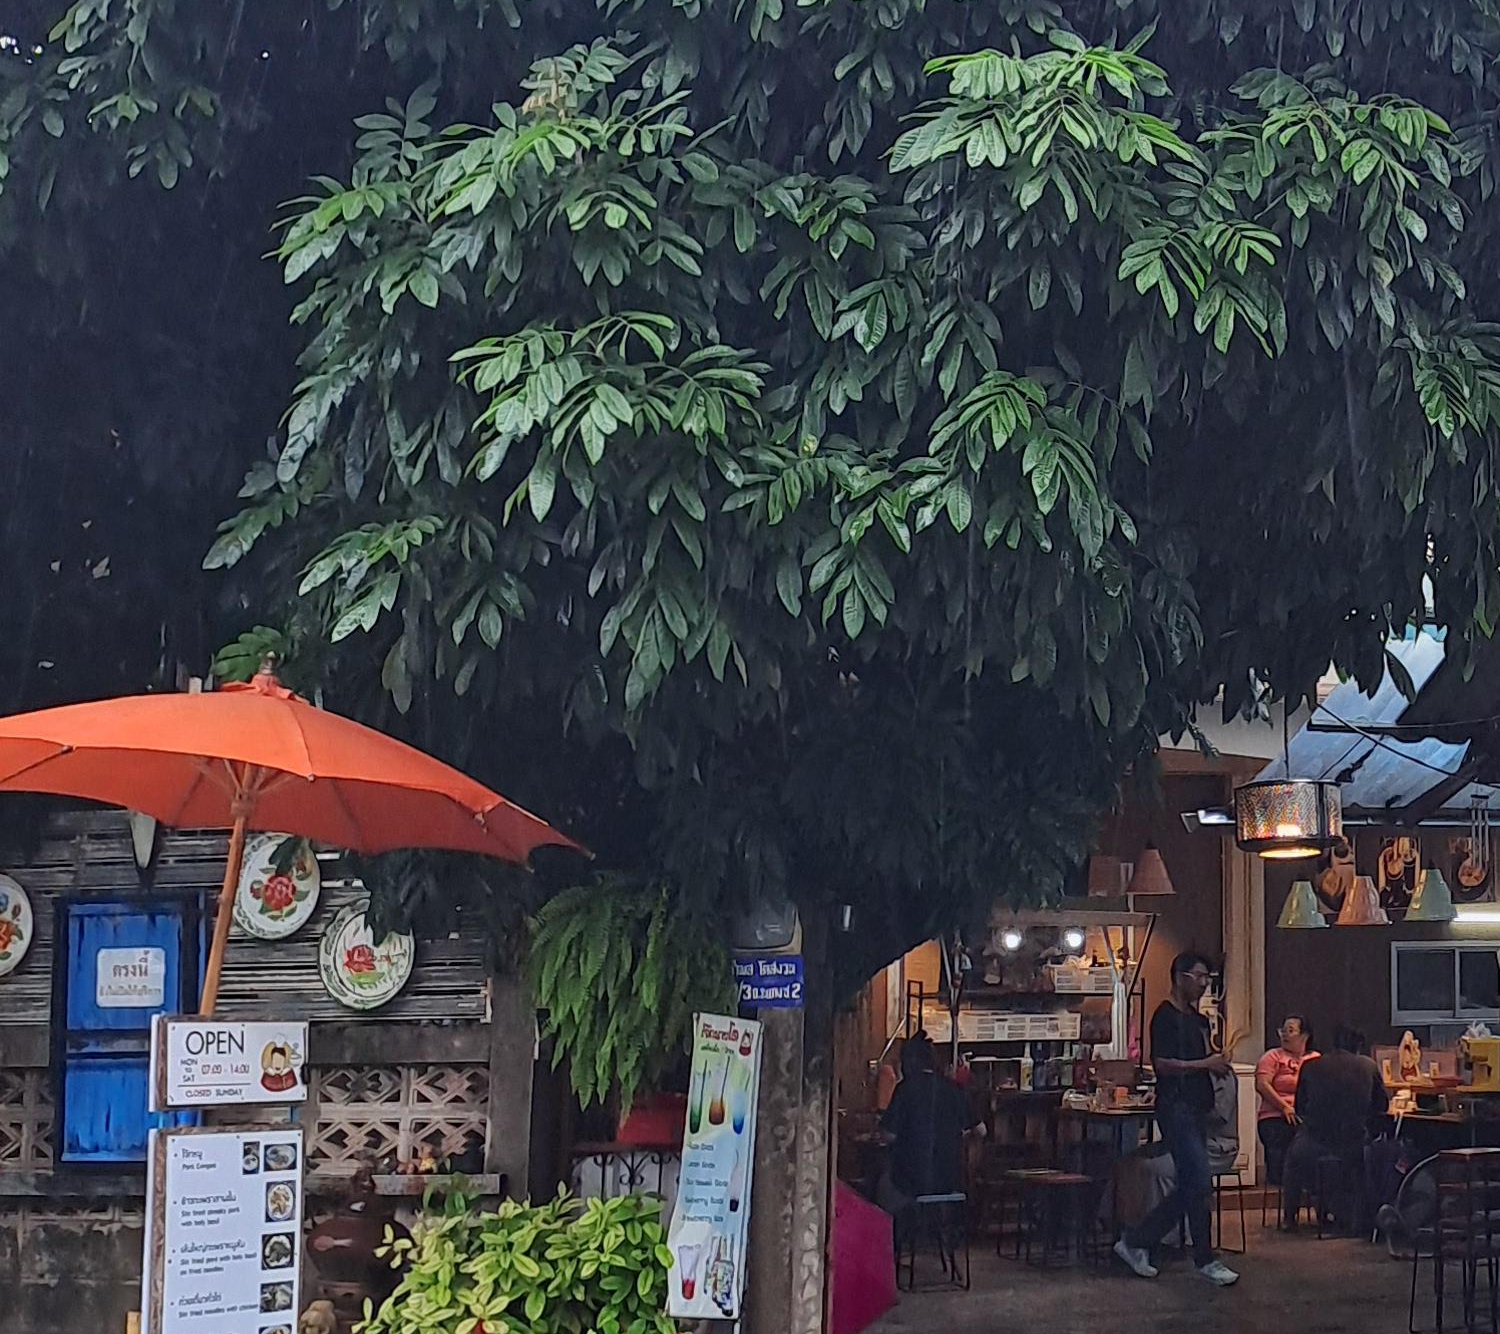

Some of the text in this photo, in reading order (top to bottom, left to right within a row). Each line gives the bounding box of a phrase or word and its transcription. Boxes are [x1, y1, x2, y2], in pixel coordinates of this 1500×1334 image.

[185, 1030, 245, 1055] OPEN
[180, 1058, 198, 1066] MON
[185, 1088, 243, 1098] CLOSED SUNDAY
